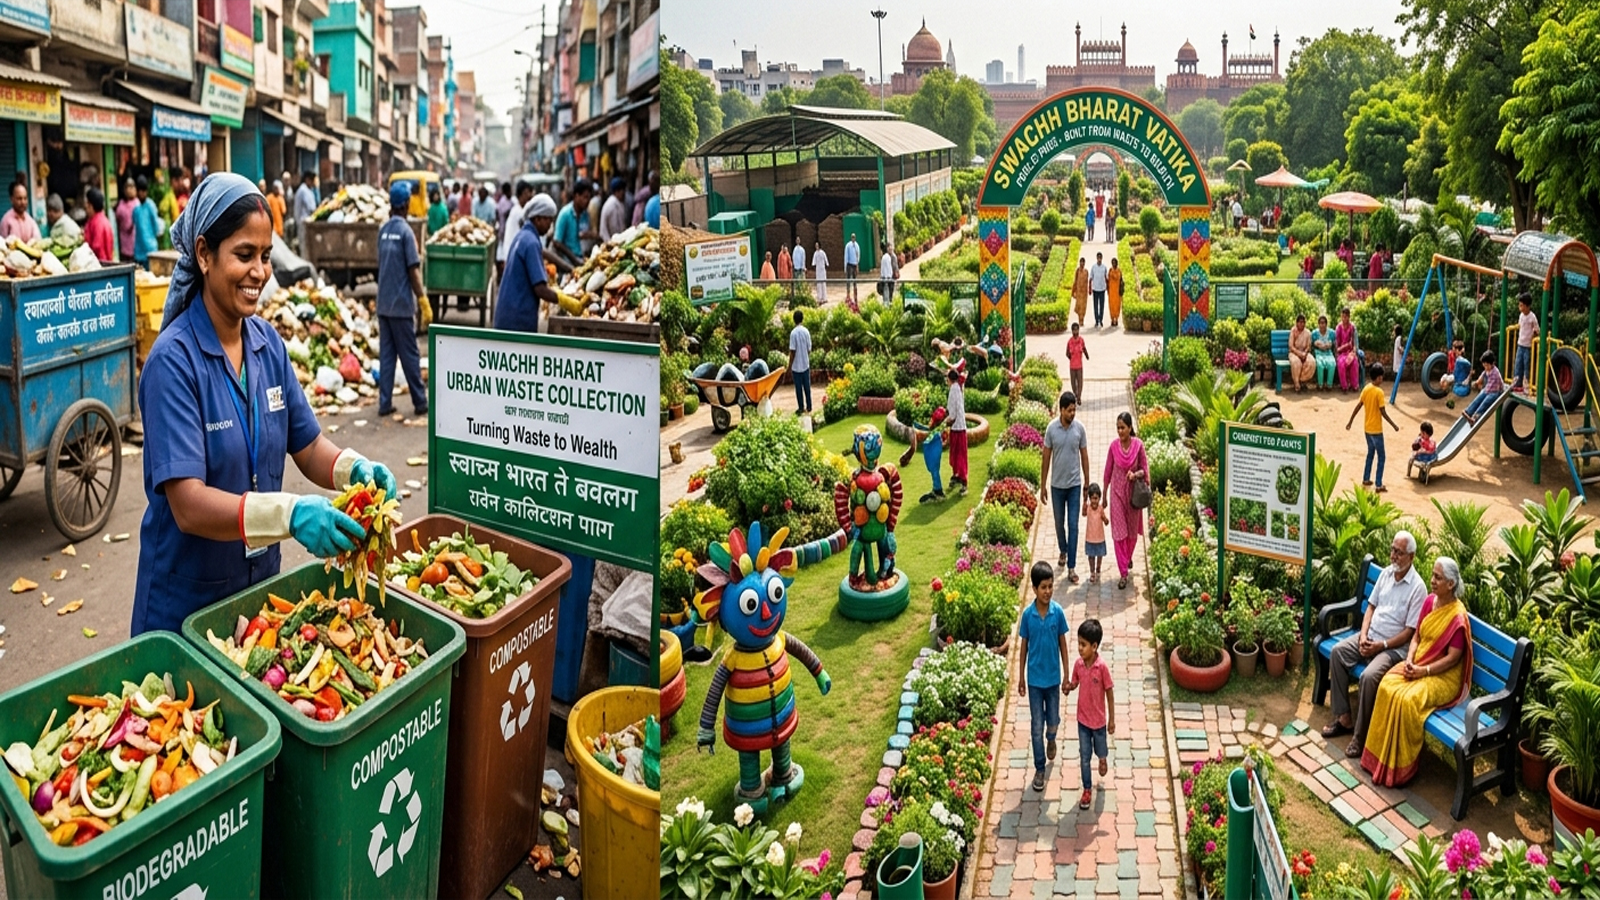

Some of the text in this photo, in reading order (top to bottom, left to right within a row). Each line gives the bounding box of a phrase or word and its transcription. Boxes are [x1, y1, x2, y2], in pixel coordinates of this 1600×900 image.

[994, 97, 1197, 194] SWACHH BHARAT VATIKA
[478, 349, 605, 383] SWACHH BHARAT
[447, 371, 492, 395] URBAN
[495, 377, 544, 403] WASTE
[548, 384, 646, 417] COLLECTION
[466, 417, 618, 461] Turning Waste to Wealth
[505, 463, 549, 492] भारत
[554, 467, 569, 497] ते
[489, 608, 554, 674] COMPOSTABLE
[351, 698, 442, 790] COMPOSTABLE
